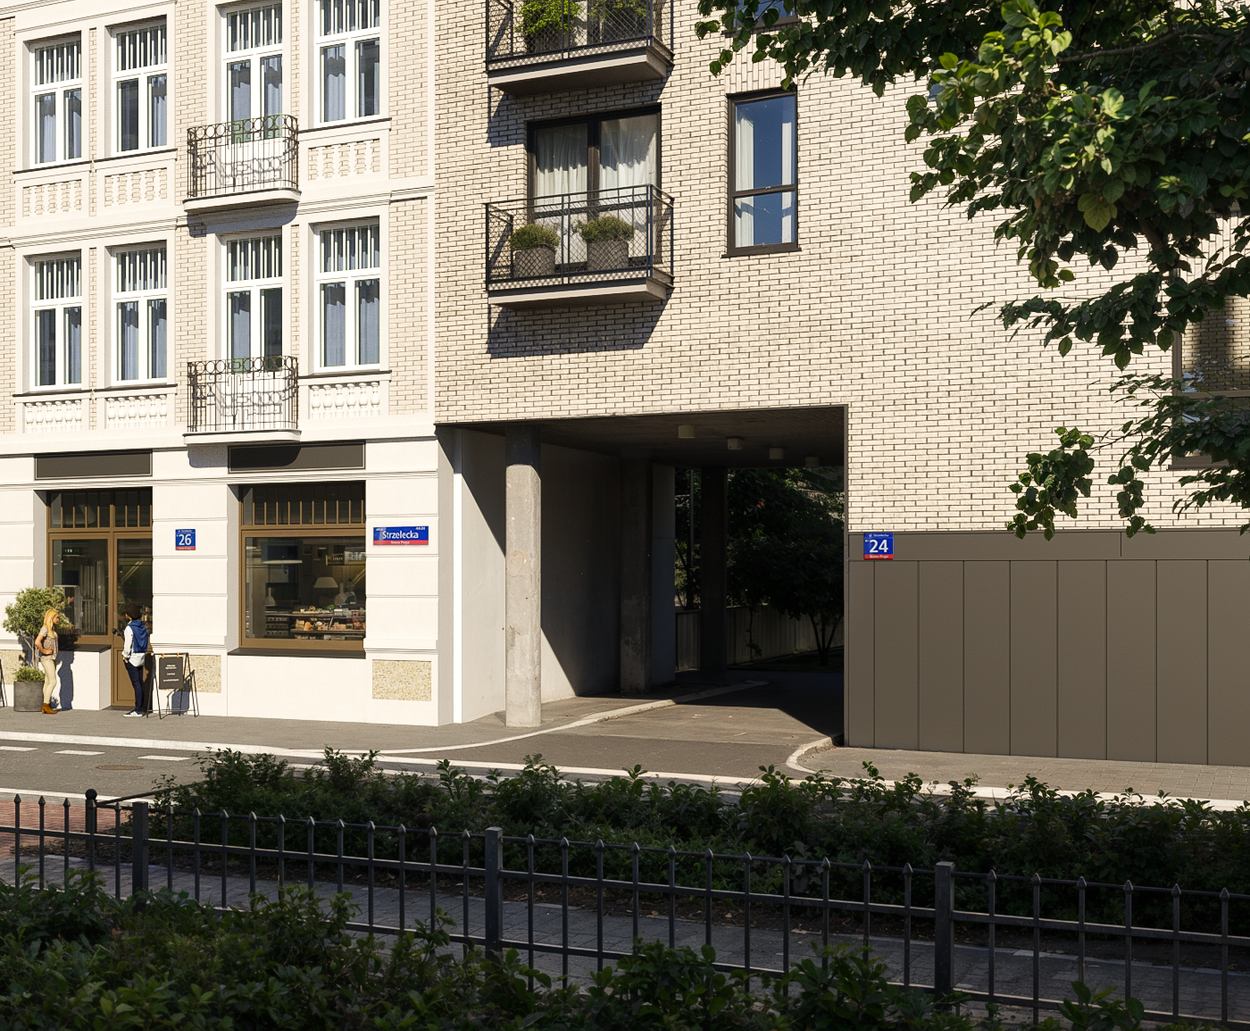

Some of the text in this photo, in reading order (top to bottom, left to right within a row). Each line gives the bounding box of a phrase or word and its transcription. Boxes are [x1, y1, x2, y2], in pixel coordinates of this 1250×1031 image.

[178, 533, 192, 546] 26
[382, 530, 419, 539] Strzelecka
[869, 539, 889, 553] 24
